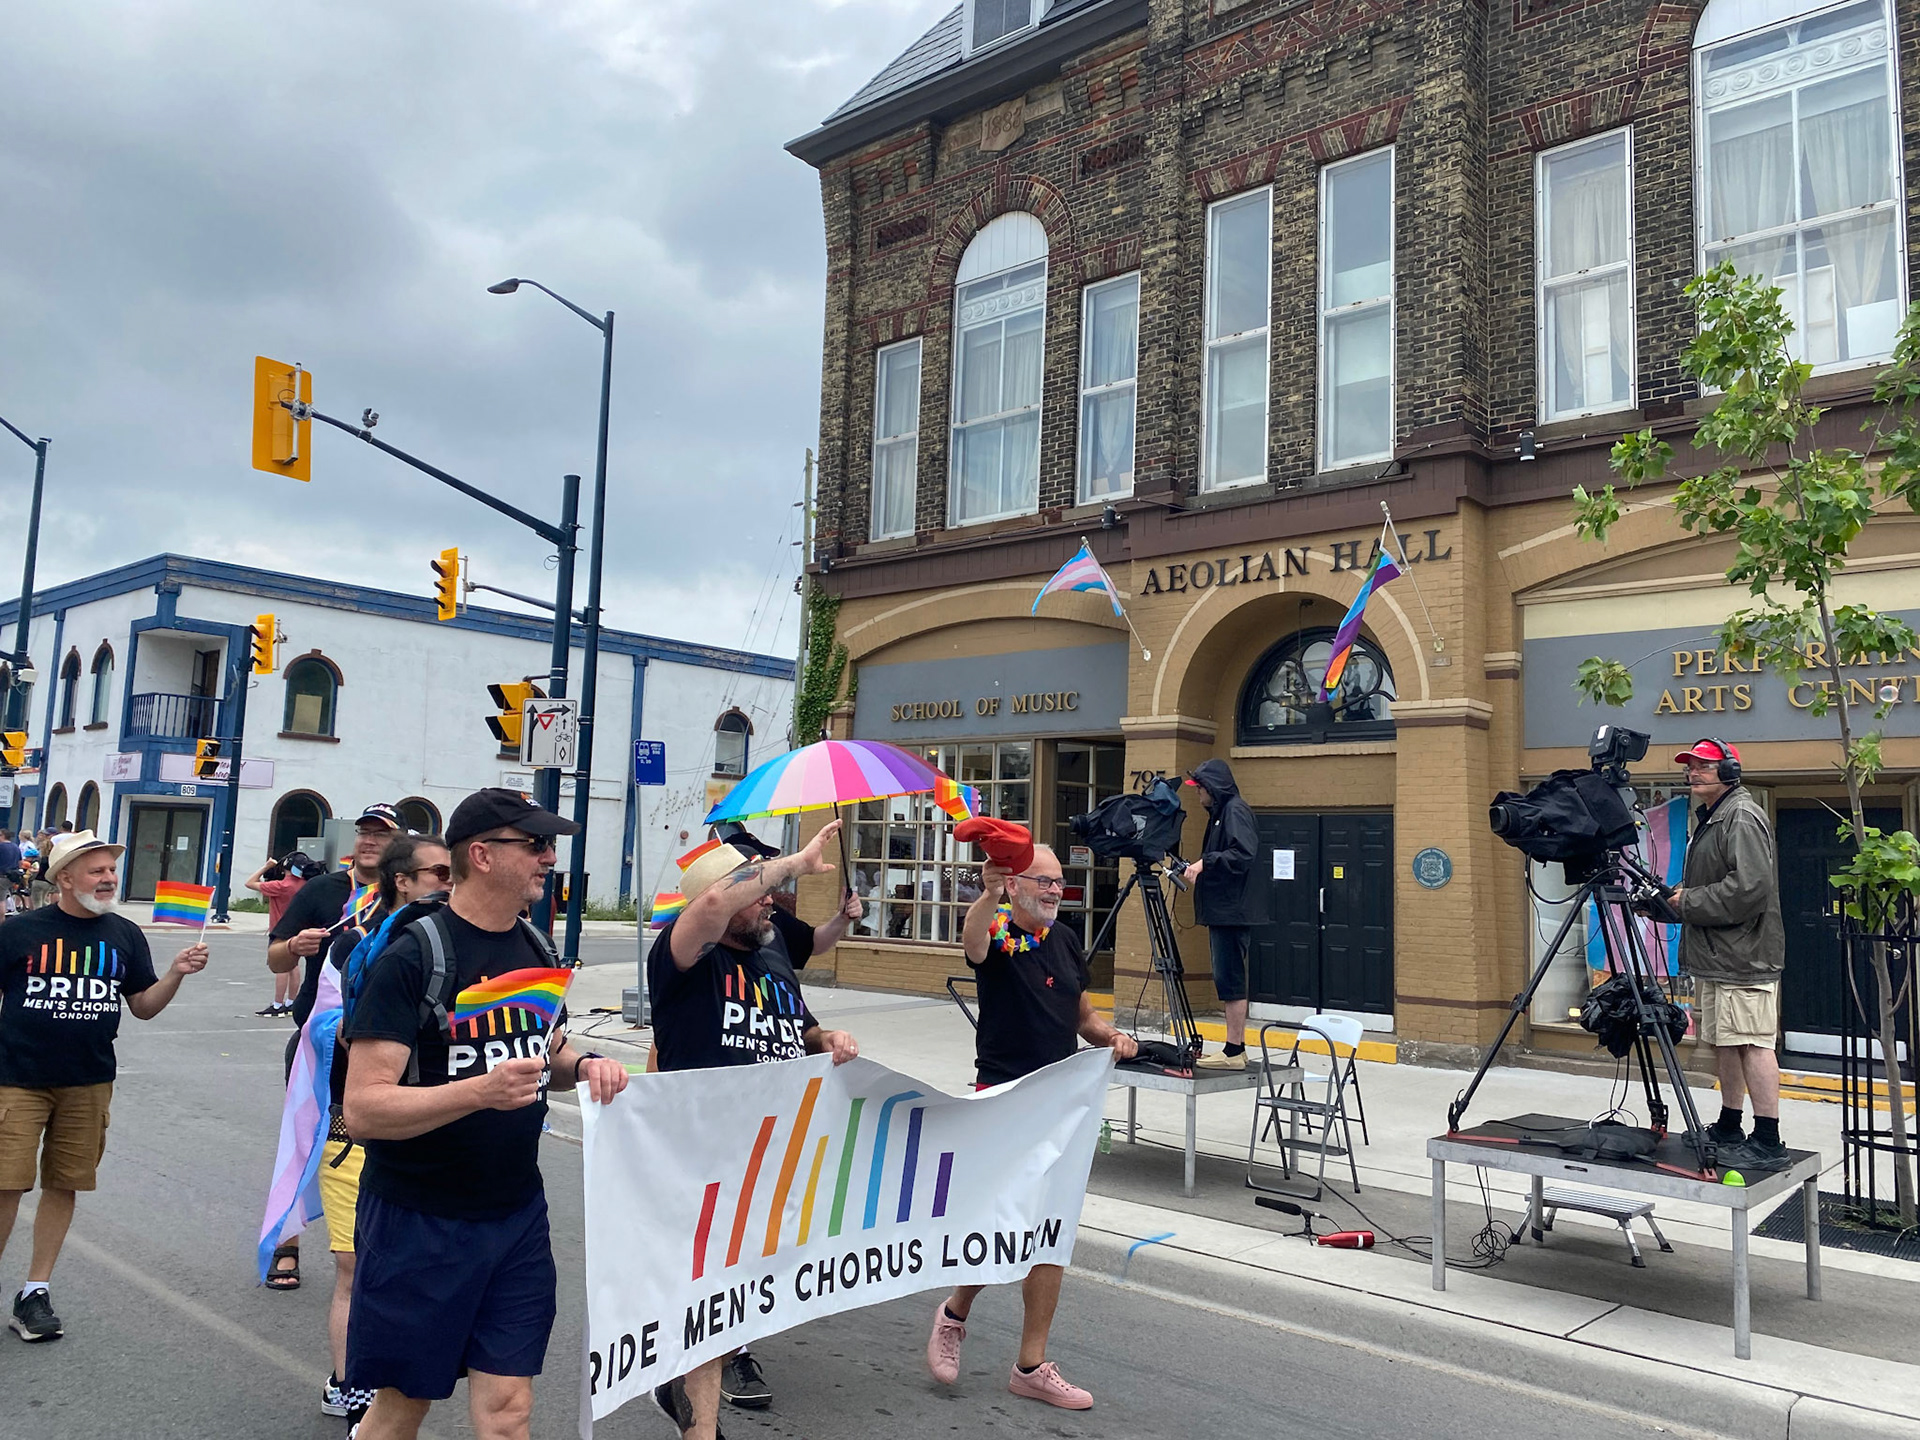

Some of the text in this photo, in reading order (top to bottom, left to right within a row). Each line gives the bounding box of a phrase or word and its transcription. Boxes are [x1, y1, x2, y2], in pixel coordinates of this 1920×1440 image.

[1140, 529, 1452, 595] AEOLIAN HALL
[891, 691, 1079, 722] SCHOOL OF MUSIC
[1653, 684, 1752, 714] ARTS
[182, 785, 195, 795] 809
[1130, 770, 1166, 790] 79
[26, 976, 121, 1001] PRIDE
[23, 998, 119, 1012] MEN'S CHORUS
[52, 1011, 99, 1020] LONDON
[448, 1035, 550, 1076] PRID
[721, 1034, 768, 1053] MEN'S
[590, 1320, 659, 1395] RIDE
[684, 1275, 774, 1350] MEN'S
[795, 1239, 922, 1301] CHORUS
